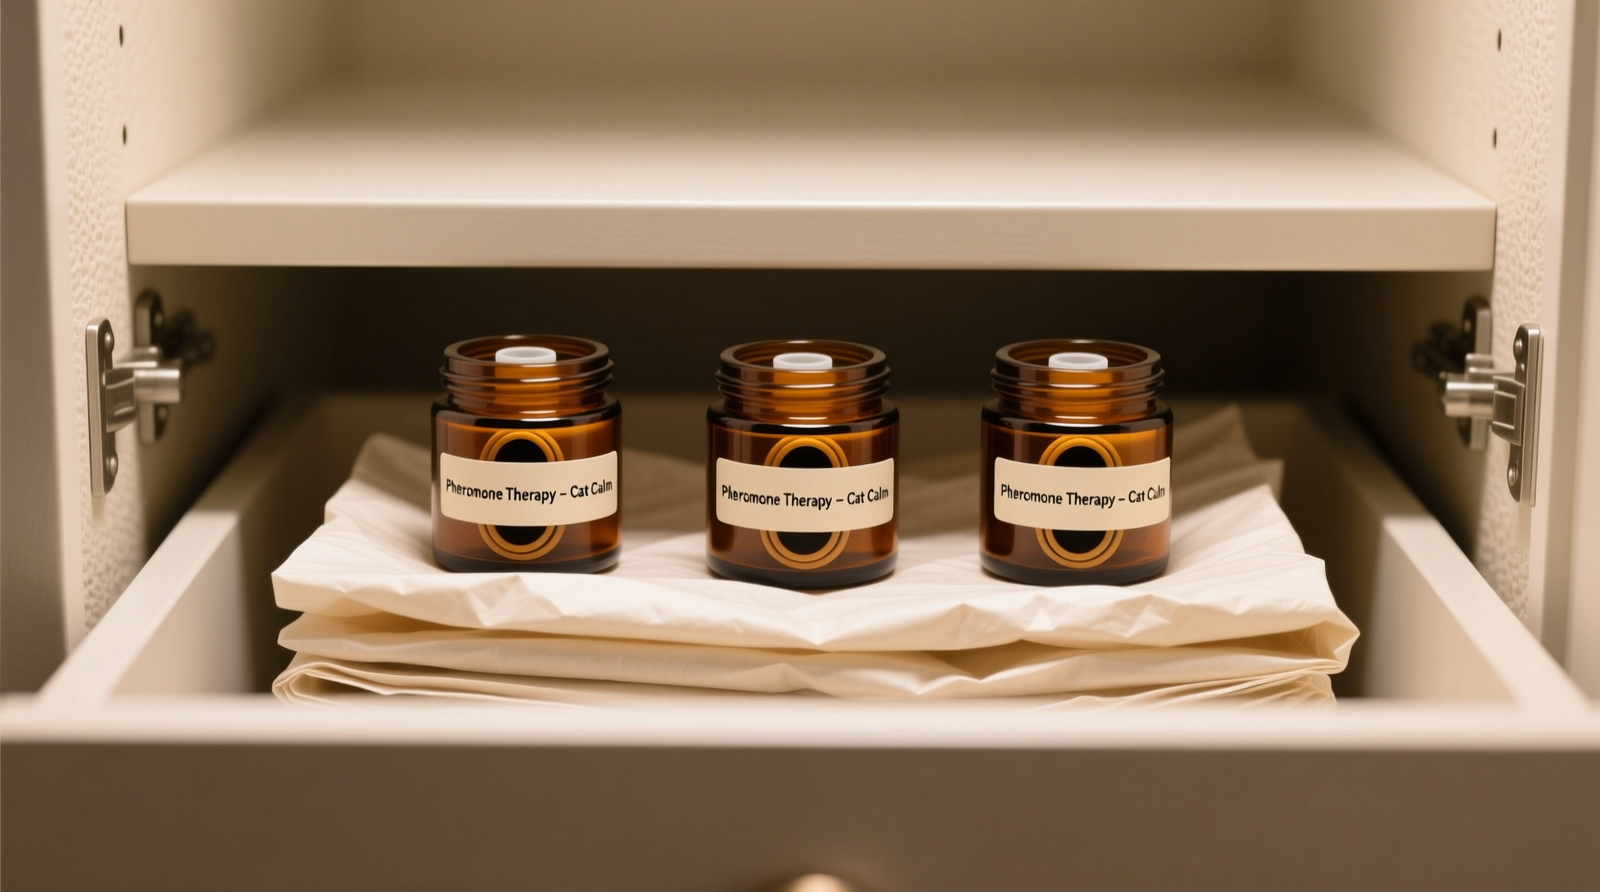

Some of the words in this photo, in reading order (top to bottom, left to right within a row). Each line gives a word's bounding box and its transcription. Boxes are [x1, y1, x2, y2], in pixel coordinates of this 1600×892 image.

[446, 478, 504, 501] Pheromone
[505, 487, 557, 505] Therapy
[570, 485, 589, 498] Cat
[590, 479, 613, 496] Calm
[721, 484, 781, 506] Pheromone
[783, 492, 833, 511] Therapy
[846, 491, 865, 505] Cat
[866, 486, 889, 503] Calm
[1000, 483, 1063, 505] Pheromone
[1065, 491, 1116, 509] Therapy
[1128, 490, 1146, 504] Cat
